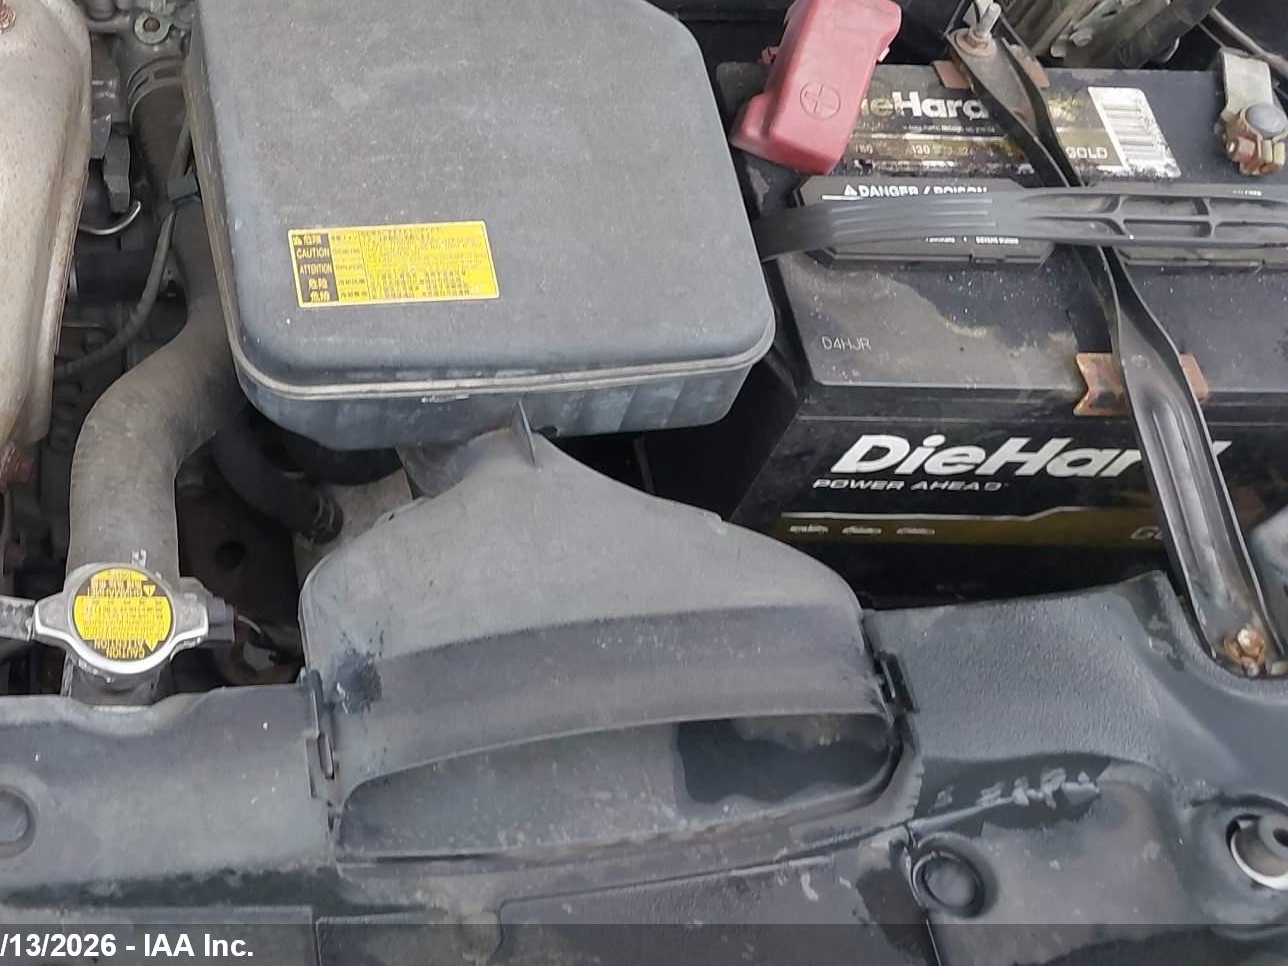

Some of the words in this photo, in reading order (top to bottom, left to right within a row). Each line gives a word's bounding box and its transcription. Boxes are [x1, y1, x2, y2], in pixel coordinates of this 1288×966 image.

[296, 247, 330, 259] CAUTION
[830, 434, 1232, 477] DieHar
[813, 479, 904, 490] POWER
[911, 480, 1002, 491] AHEAD
